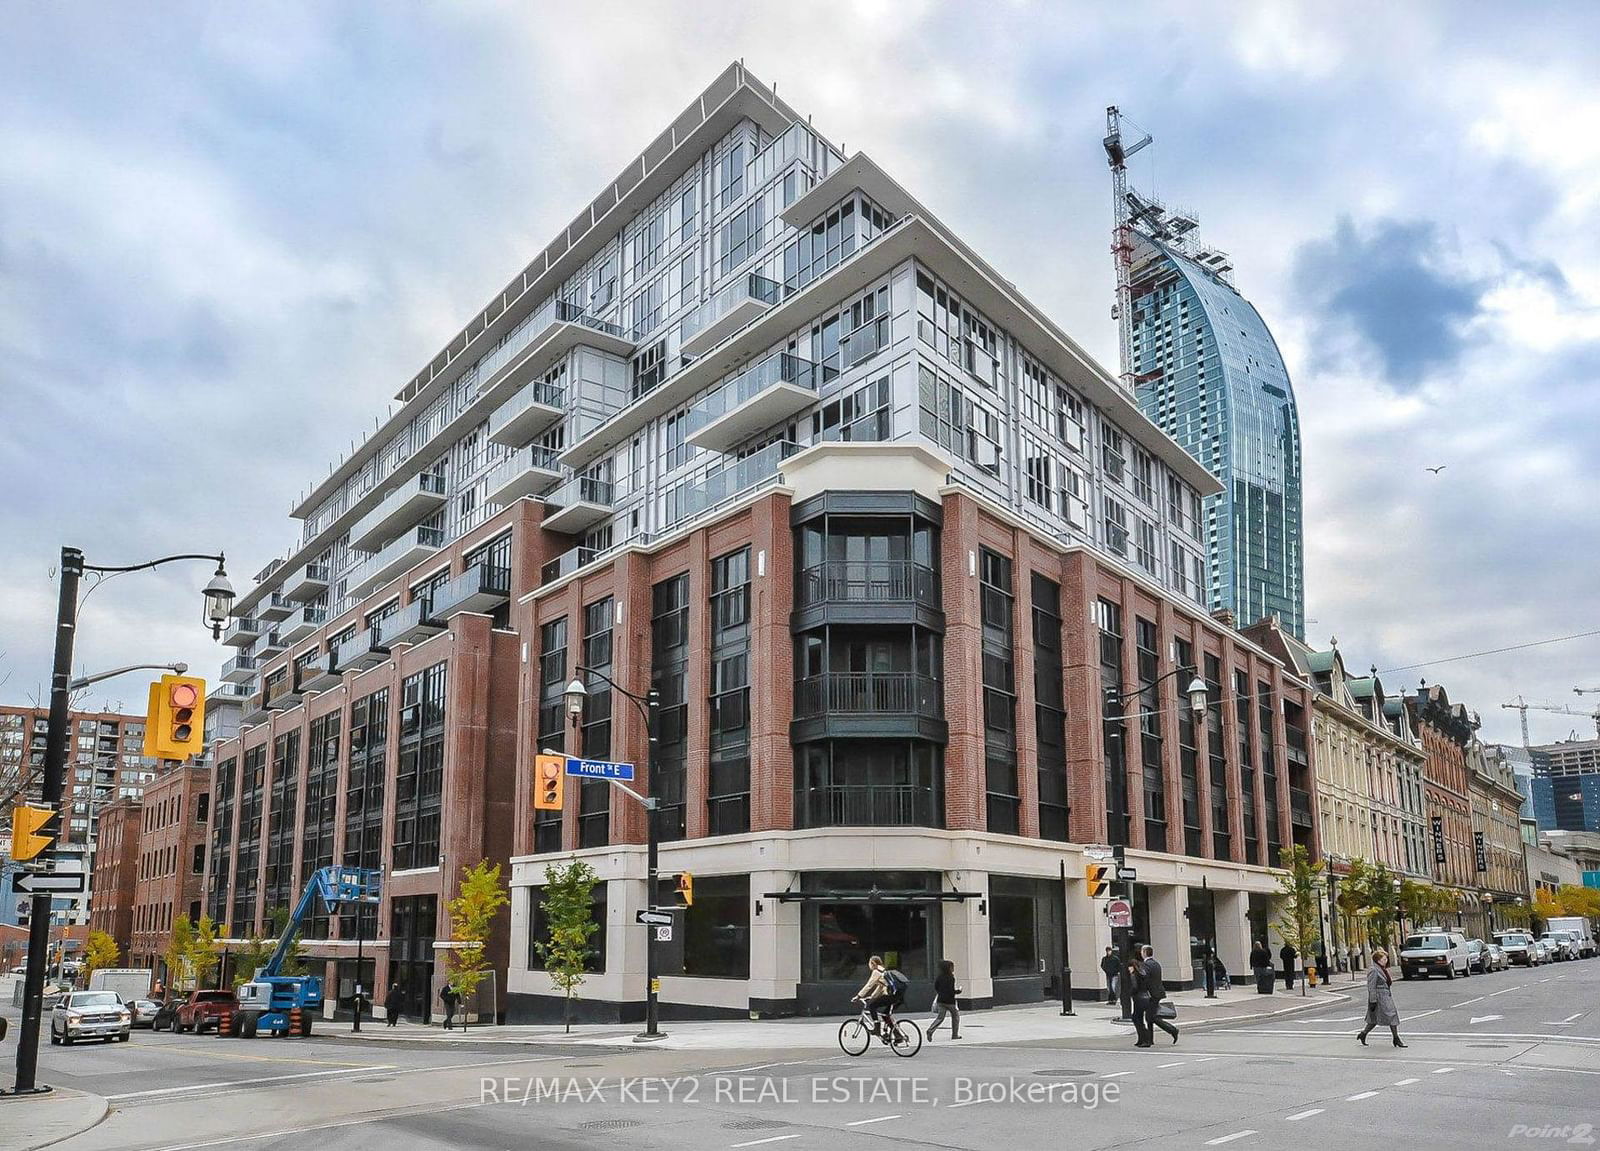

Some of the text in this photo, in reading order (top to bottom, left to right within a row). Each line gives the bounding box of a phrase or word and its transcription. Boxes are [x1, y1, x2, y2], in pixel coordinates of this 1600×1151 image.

[580, 762, 605, 774] Front
[614, 765, 620, 775] E
[1432, 820, 1444, 861] WINNERS
[1475, 834, 1485, 869] WINNERS
